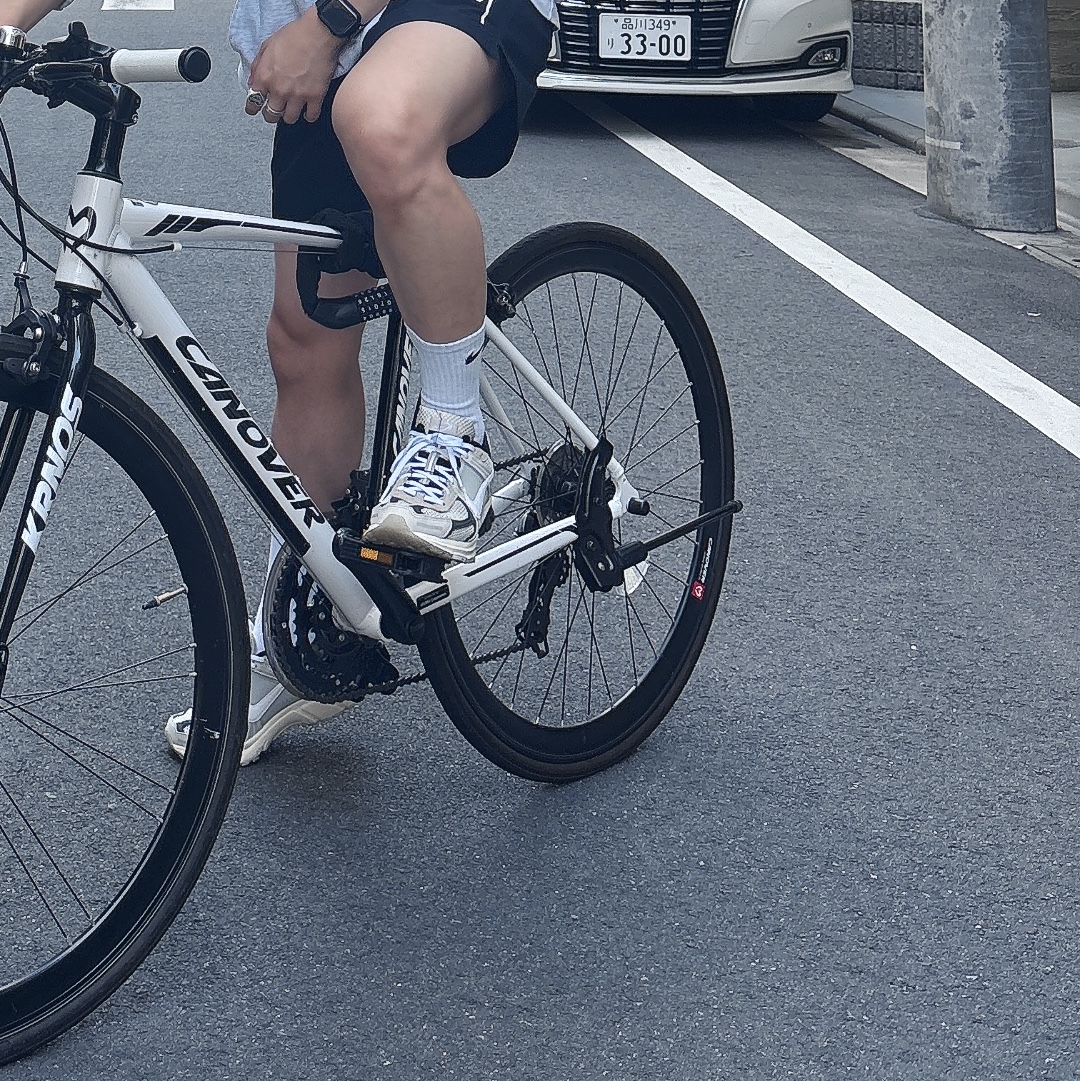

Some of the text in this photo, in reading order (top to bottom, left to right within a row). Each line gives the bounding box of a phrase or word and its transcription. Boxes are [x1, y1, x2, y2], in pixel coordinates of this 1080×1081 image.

[607, 32, 686, 57] リ 33-00
[21, 381, 83, 555] KRNOS
[175, 335, 326, 529] CANOVER
